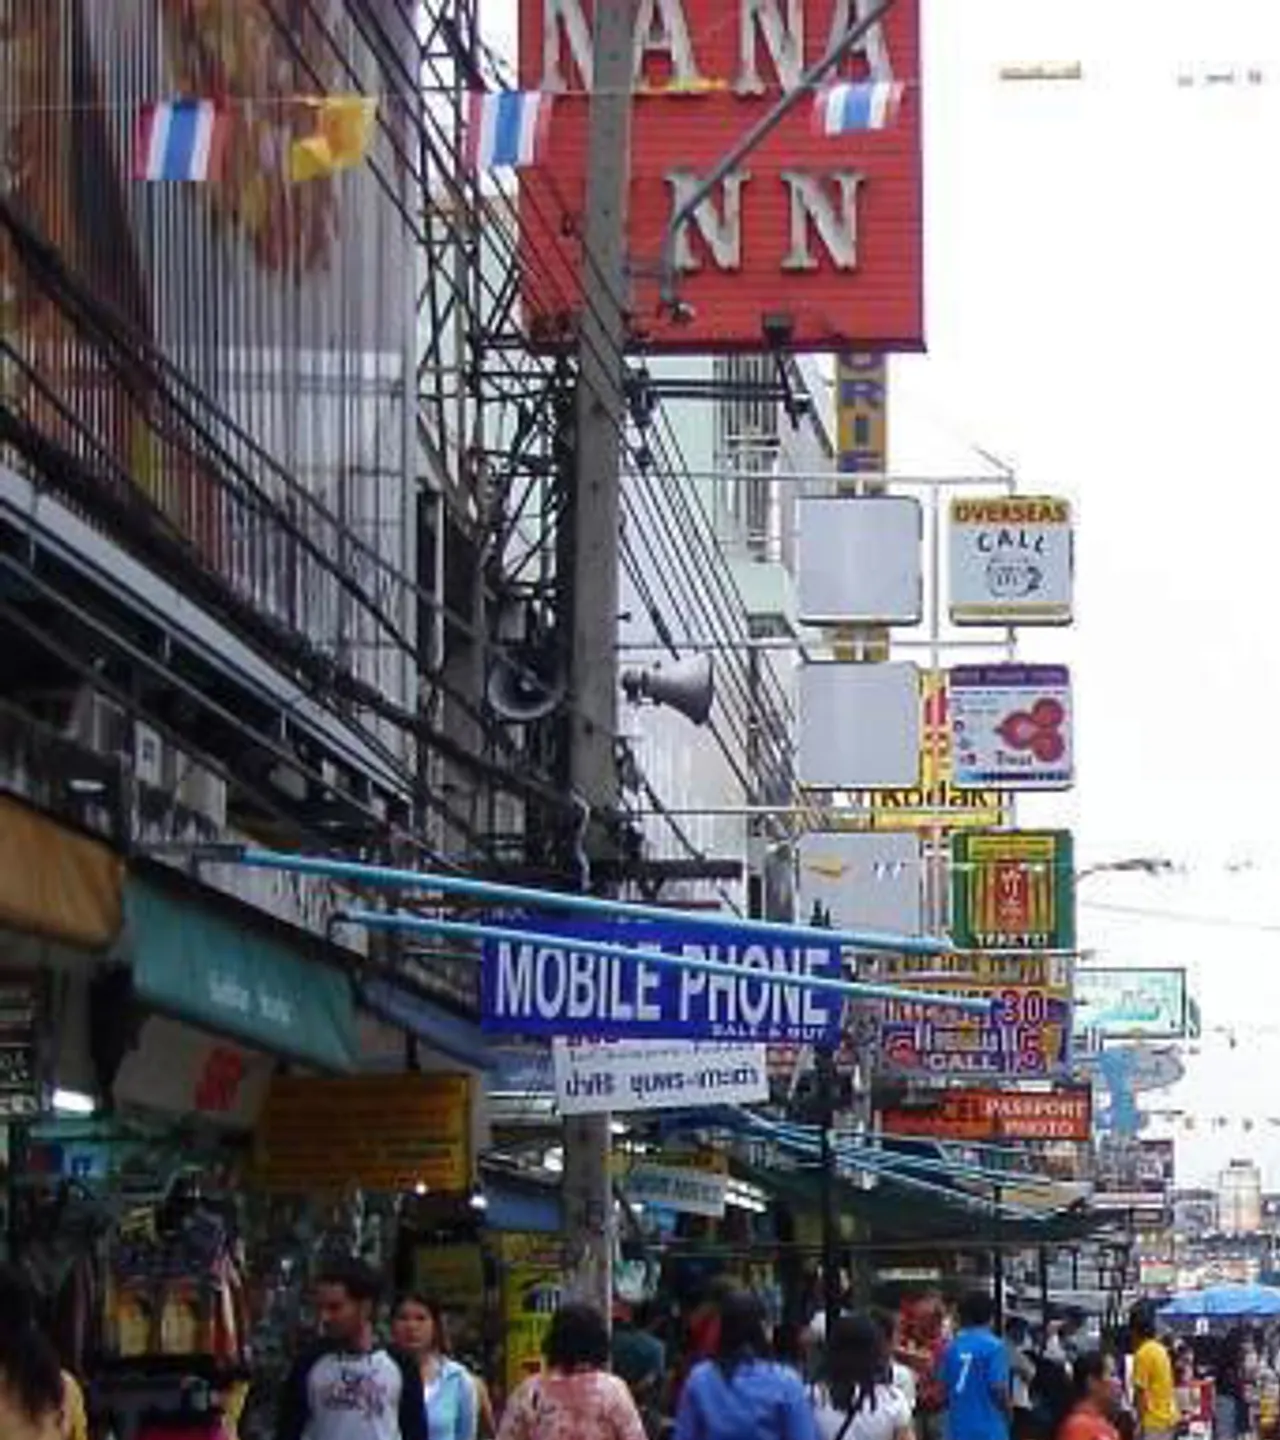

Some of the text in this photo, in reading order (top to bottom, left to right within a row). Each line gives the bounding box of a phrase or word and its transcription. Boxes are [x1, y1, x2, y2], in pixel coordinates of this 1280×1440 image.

[664, 168, 870, 273] NN
[954, 501, 1067, 524] OVERSEAS
[494, 940, 831, 1026] MOBILE PHONE
